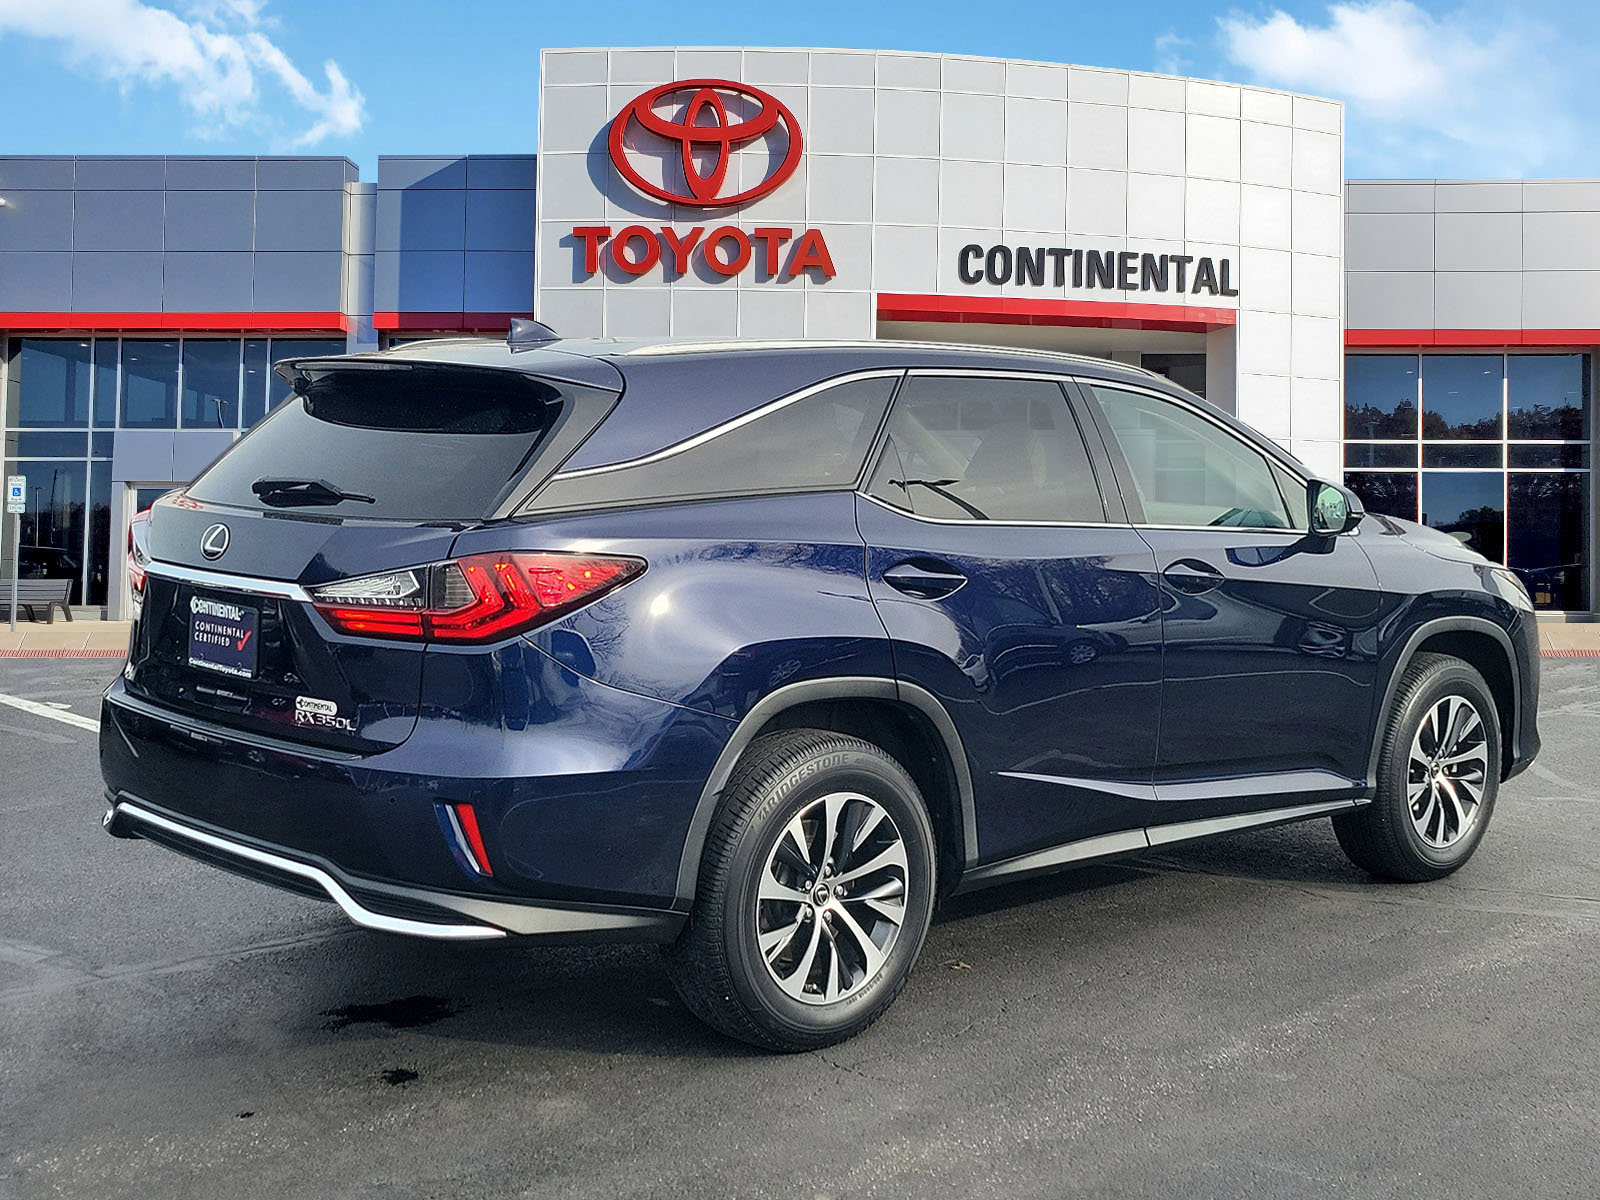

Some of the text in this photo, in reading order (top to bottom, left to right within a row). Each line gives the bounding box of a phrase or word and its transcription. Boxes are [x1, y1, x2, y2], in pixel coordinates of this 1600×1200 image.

[573, 225, 836, 277] TOYOTA
[958, 243, 1239, 297] CONTINENTAL
[190, 596, 242, 621] CONTINENTAL
[194, 631, 230, 647] CERTIFIED
[195, 620, 244, 639] CONTINENTAL
[758, 753, 850, 822] BRIDGESTONE
